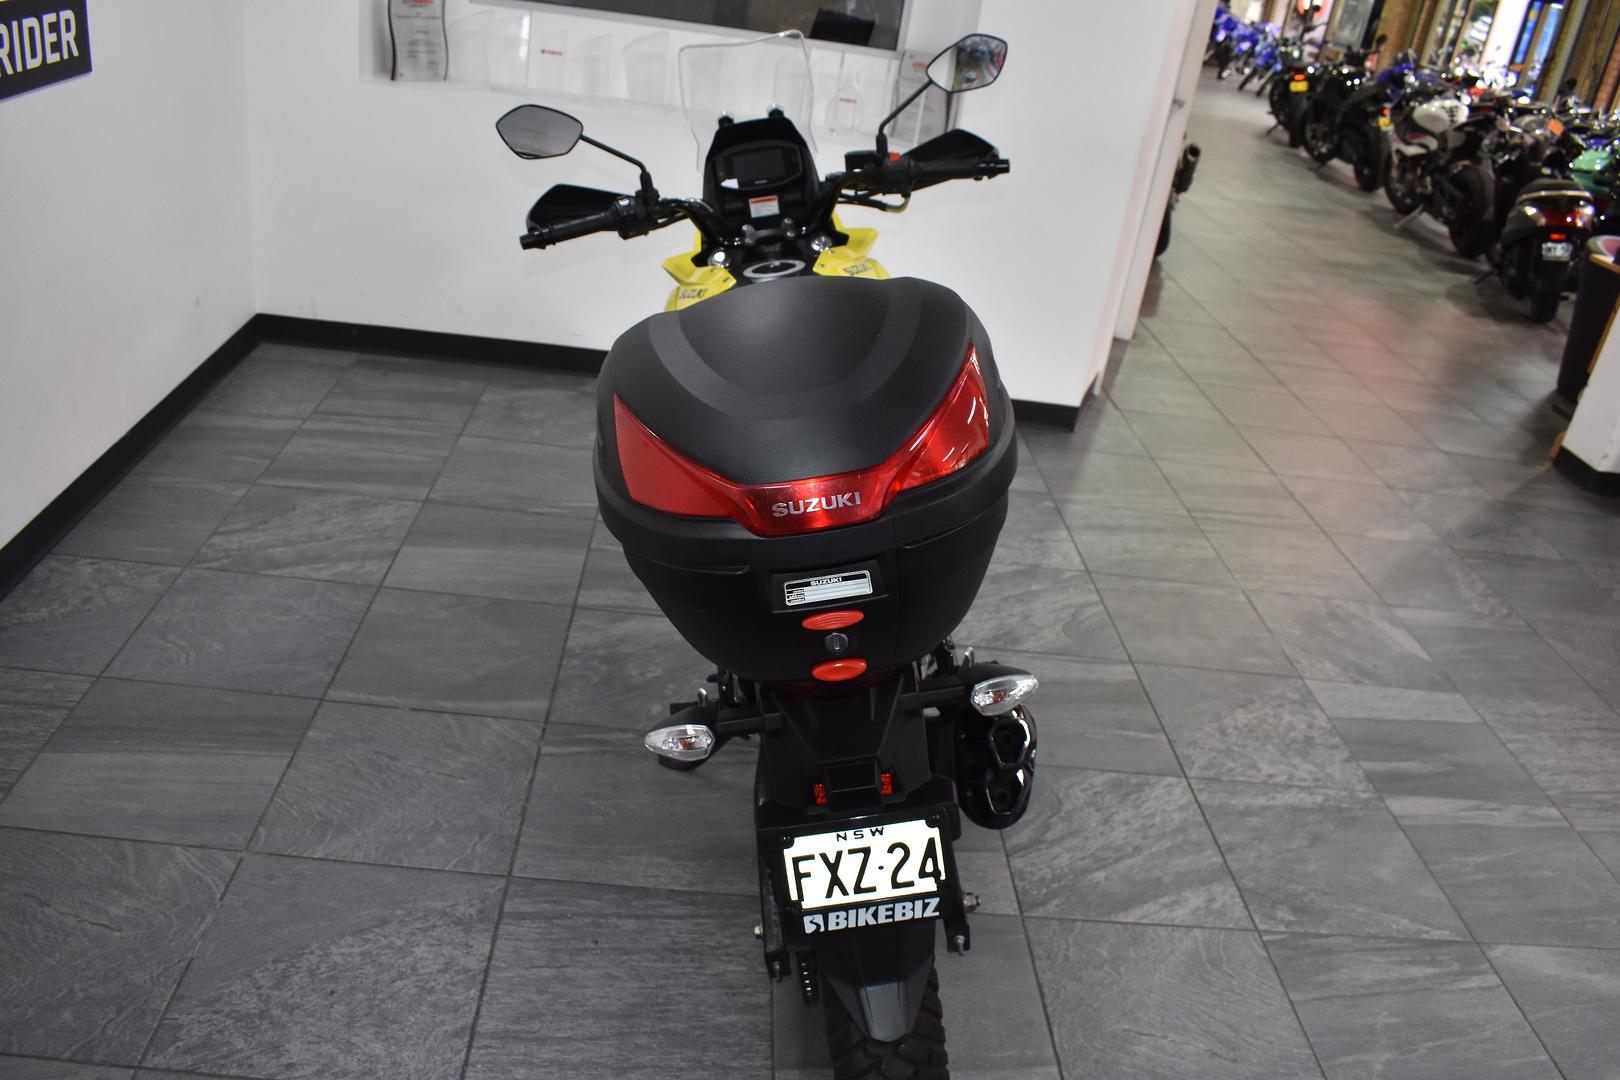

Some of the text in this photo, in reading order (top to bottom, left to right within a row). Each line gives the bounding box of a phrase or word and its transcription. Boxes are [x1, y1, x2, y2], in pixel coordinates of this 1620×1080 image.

[0, 9, 79, 77] RIDER
[772, 491, 861, 517] SUZUKI
[810, 576, 842, 586] SUZUKI
[836, 826, 884, 842] NSW
[828, 897, 940, 931] BIKEBIZ
